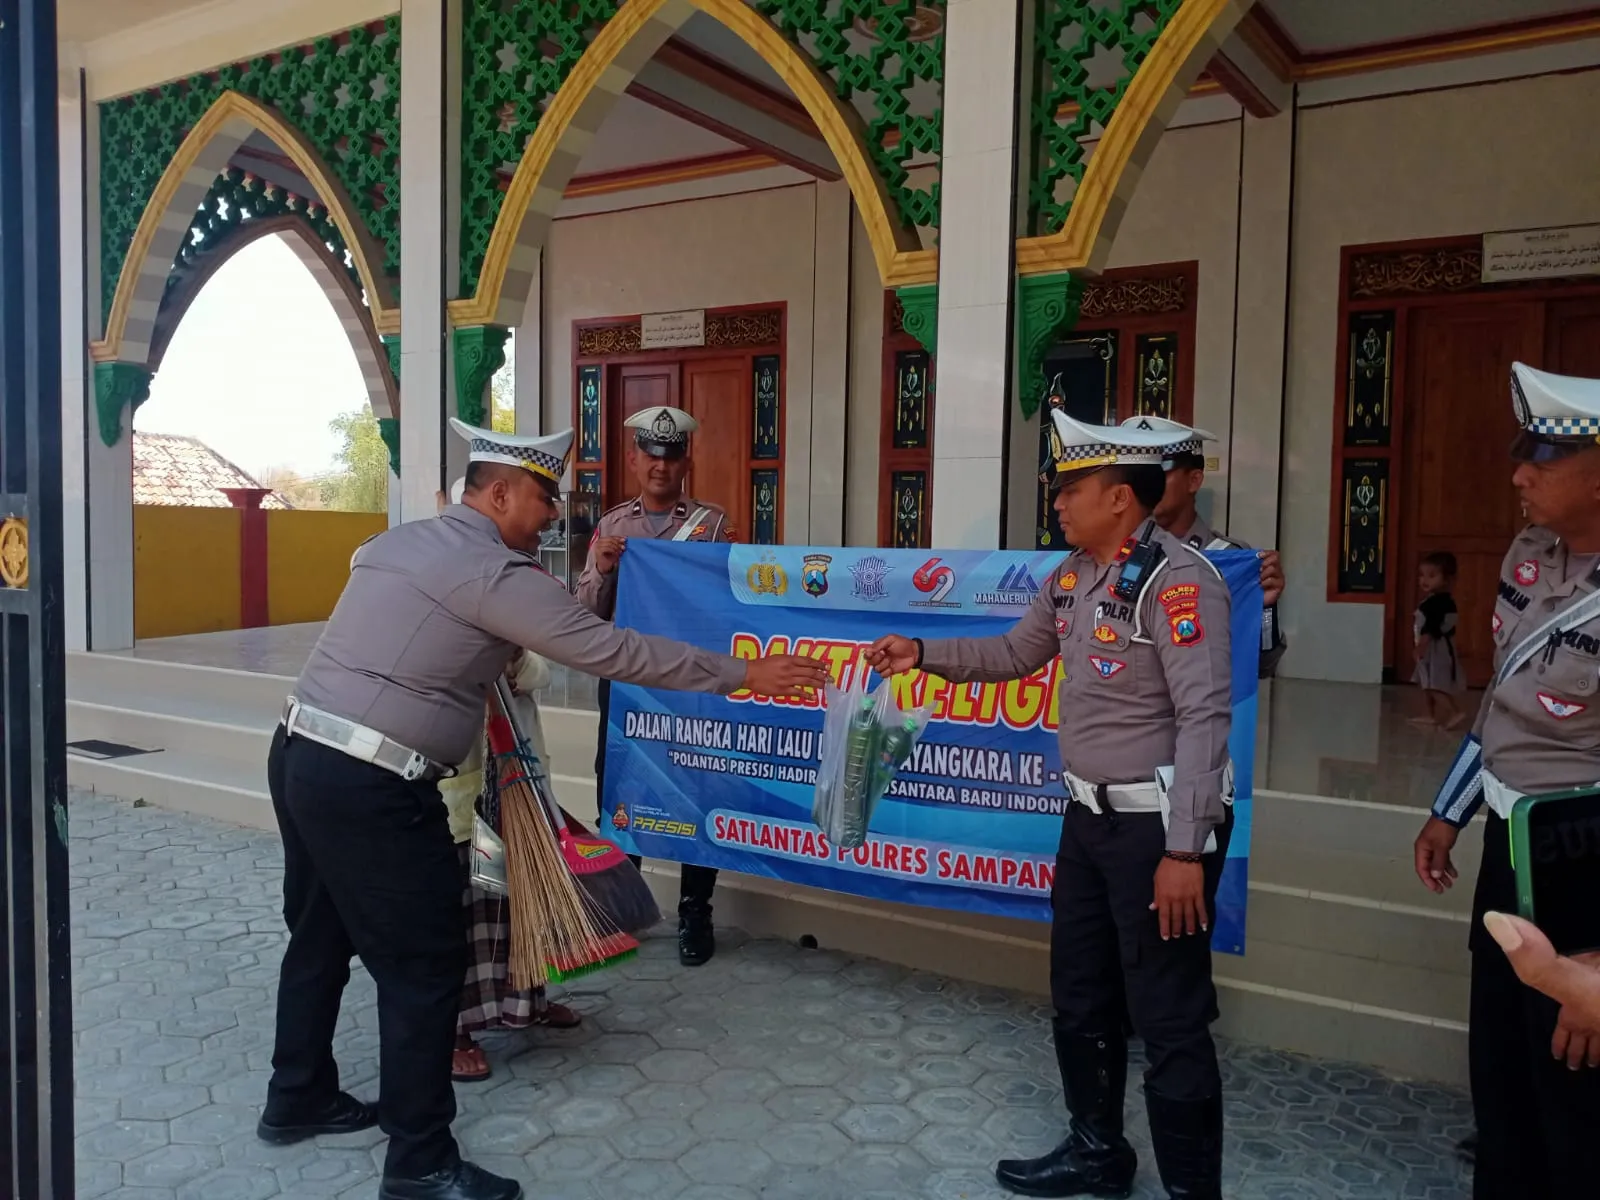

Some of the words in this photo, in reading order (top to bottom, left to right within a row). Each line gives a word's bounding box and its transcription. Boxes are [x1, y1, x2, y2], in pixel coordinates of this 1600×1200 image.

[973, 592, 1027, 607] MAHAMERU
[625, 711, 672, 742] DALAM
[675, 717, 732, 750] RANGKA
[736, 723, 773, 755] HARI
[776, 729, 813, 760] LALU
[730, 759, 774, 779] PRESISI
[778, 766, 816, 784] HADIR
[1019, 754, 1044, 786] KE
[961, 789, 1002, 808] BARU
[1007, 794, 1067, 815] INDON
[714, 815, 830, 859] SATLANTAS
[937, 850, 1056, 890] SAMPAN
